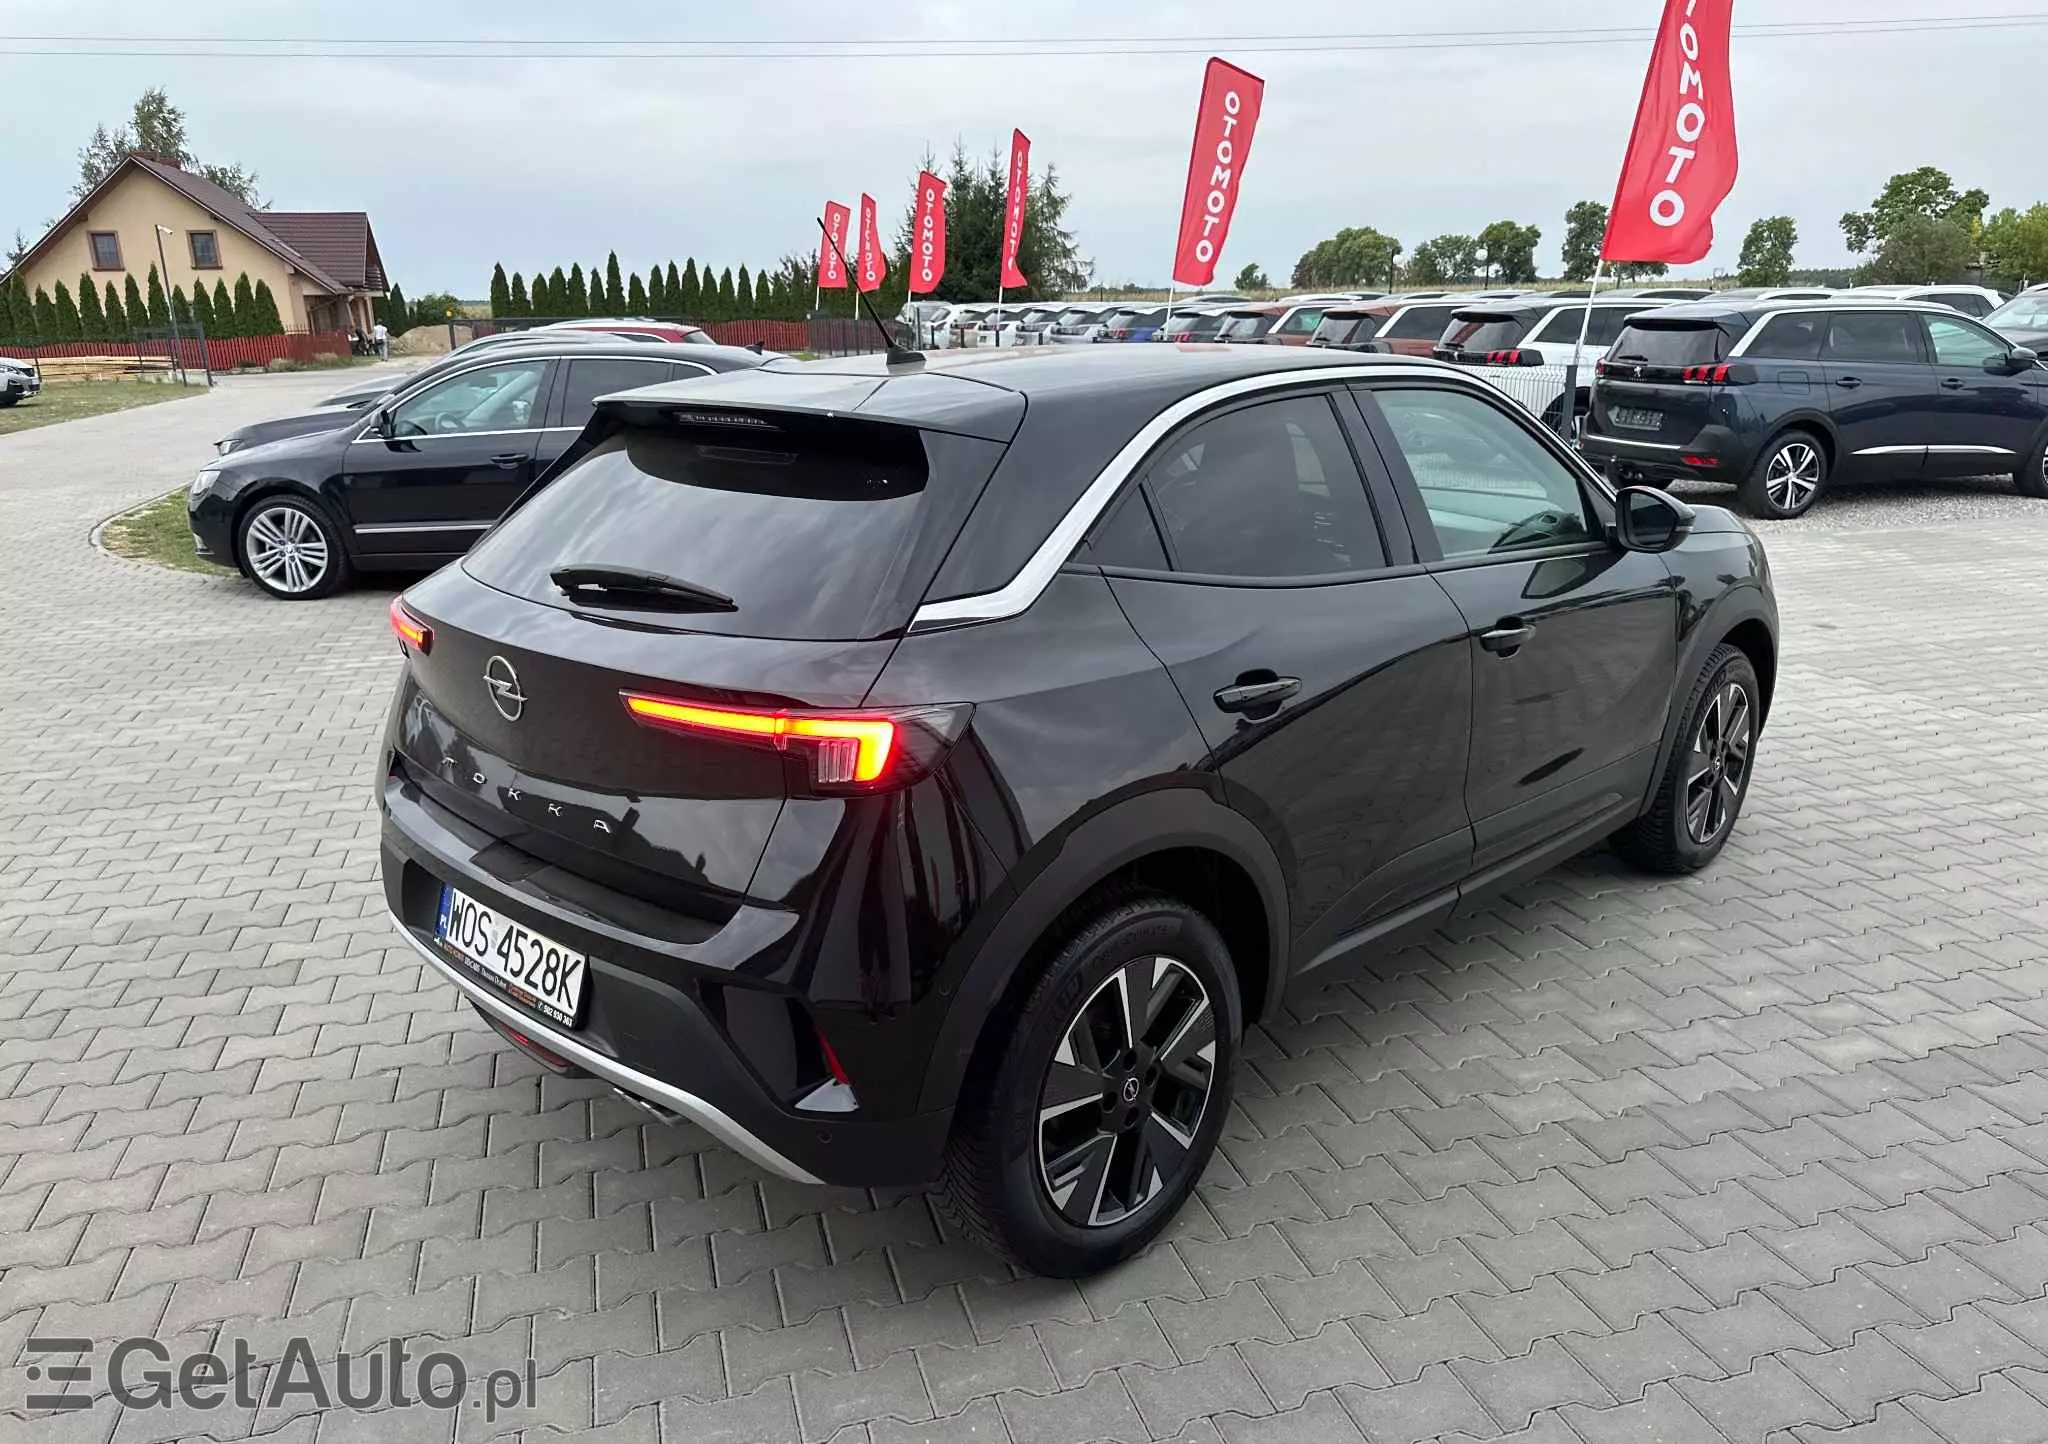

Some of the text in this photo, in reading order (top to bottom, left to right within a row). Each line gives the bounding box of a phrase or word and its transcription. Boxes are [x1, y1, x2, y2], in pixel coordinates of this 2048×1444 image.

[922, 188, 935, 281] OTOMOTO
[1195, 91, 1241, 263] OTOMOTO
[449, 892, 582, 1011] WOS 4528K
